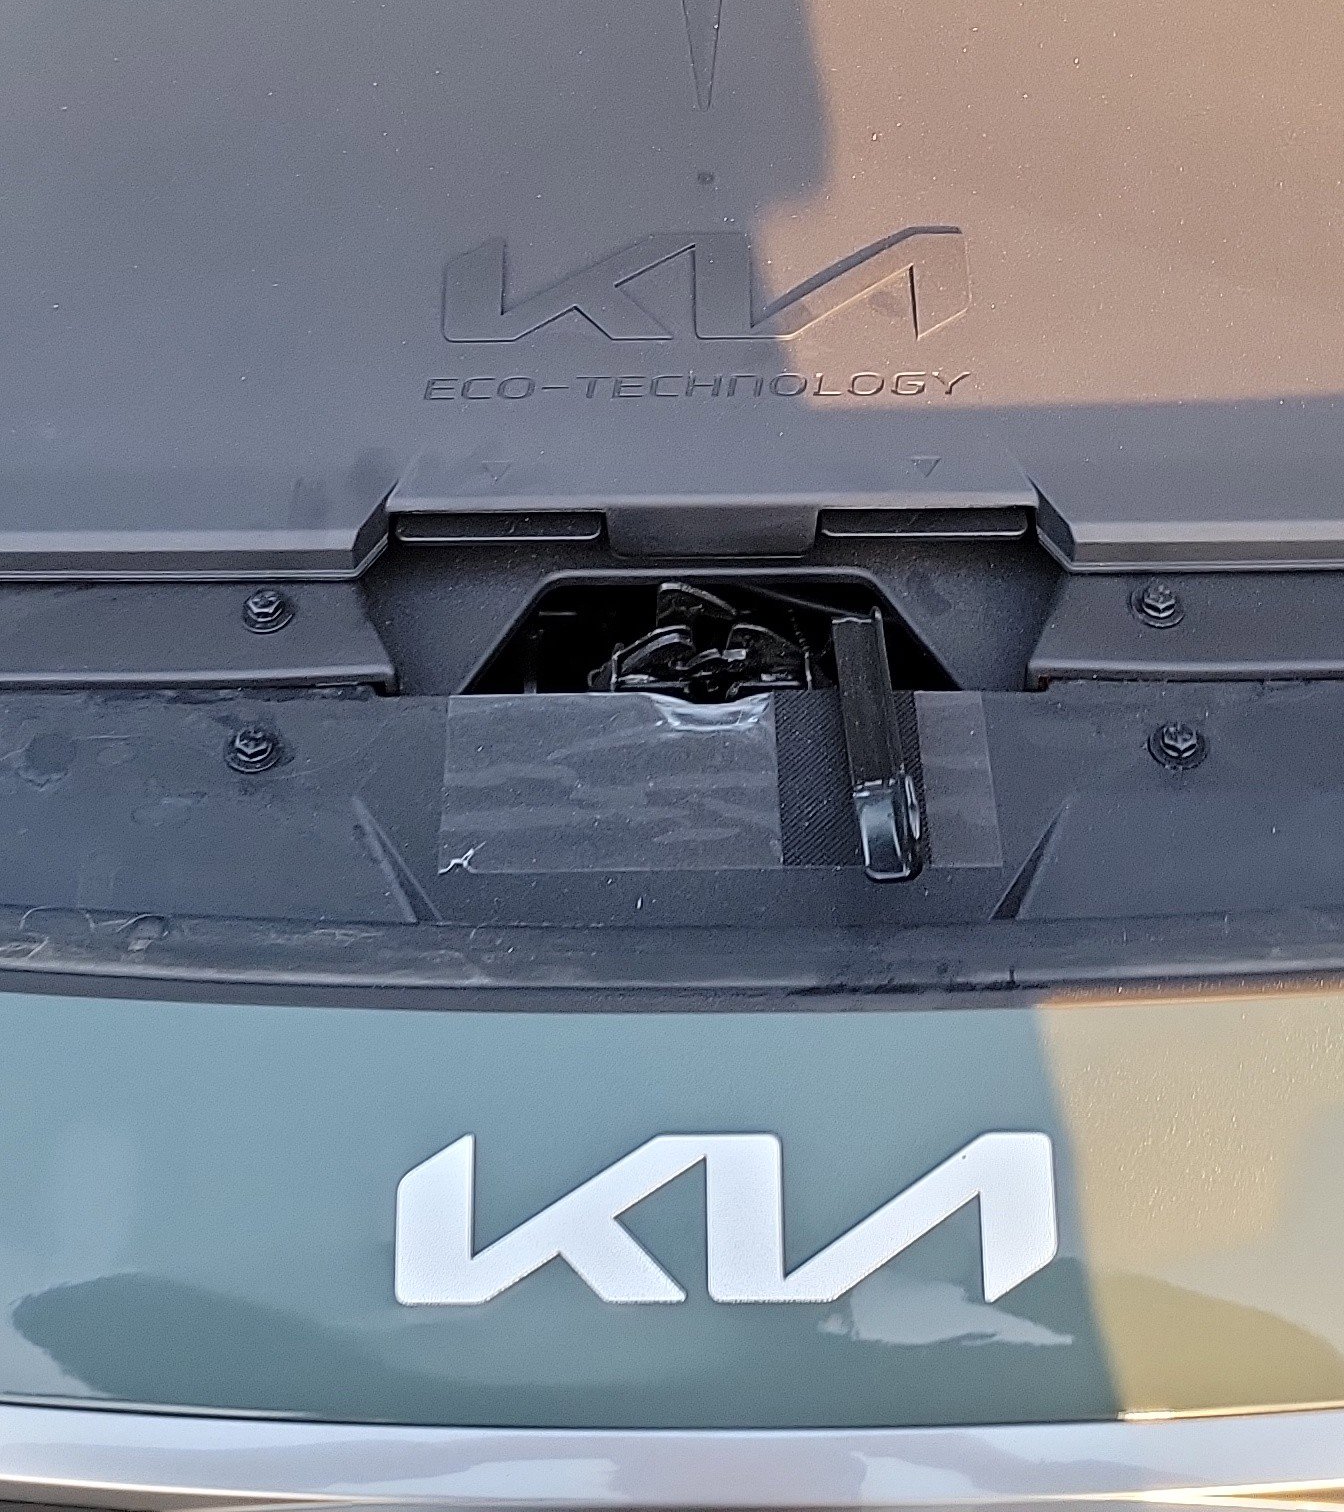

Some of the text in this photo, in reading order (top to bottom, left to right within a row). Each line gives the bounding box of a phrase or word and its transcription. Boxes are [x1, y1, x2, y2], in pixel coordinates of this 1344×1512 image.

[441, 225, 973, 343] KIA
[423, 370, 973, 401] ECO-TECHNOLOGY
[394, 1130, 1059, 1306] KIA
